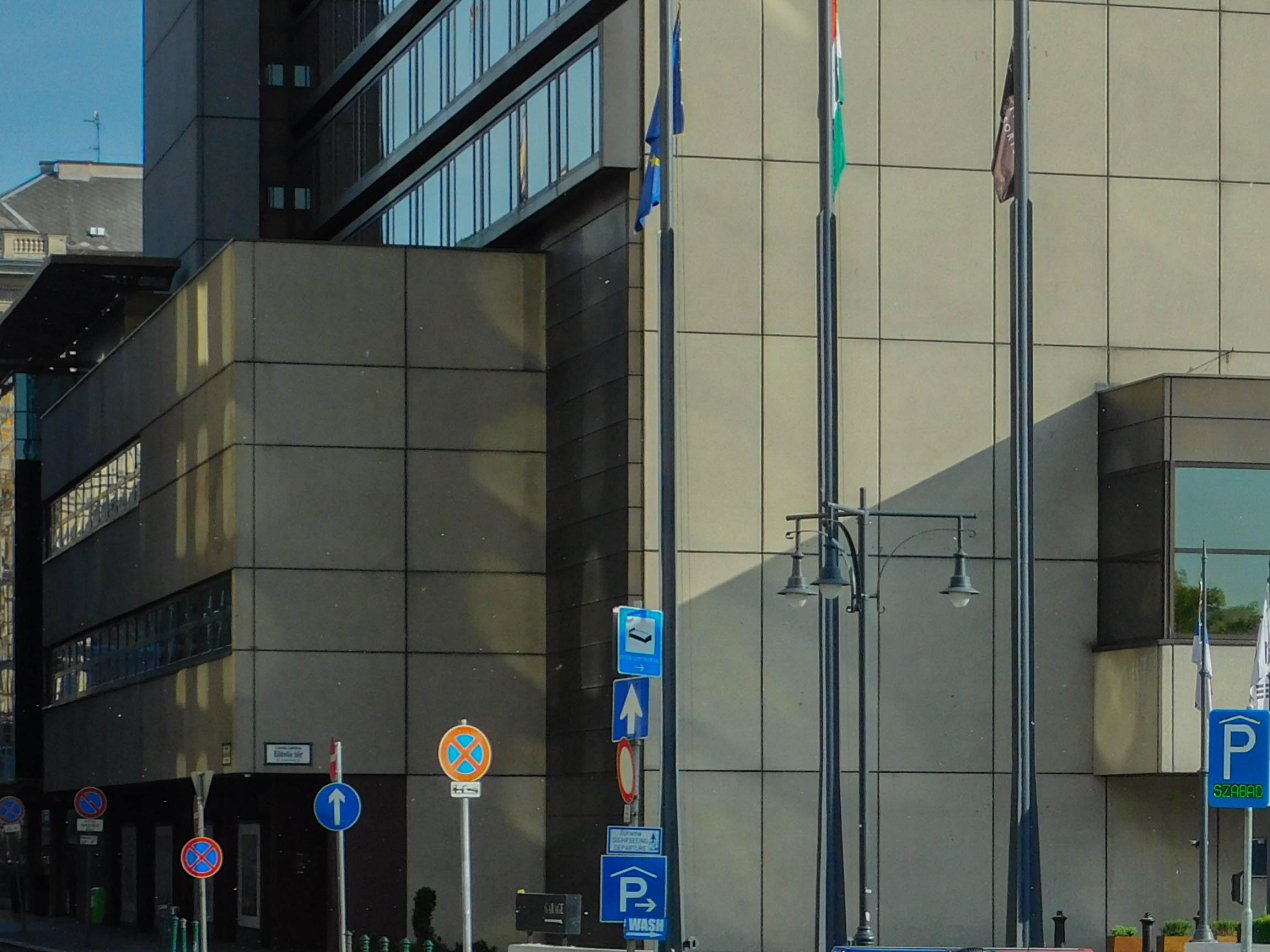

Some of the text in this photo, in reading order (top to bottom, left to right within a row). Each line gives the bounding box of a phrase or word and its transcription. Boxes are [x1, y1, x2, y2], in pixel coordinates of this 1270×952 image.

[1223, 723, 1257, 781] P
[1213, 784, 1264, 799] SZABAD
[619, 876, 649, 913] P
[628, 917, 665, 932] WASH
